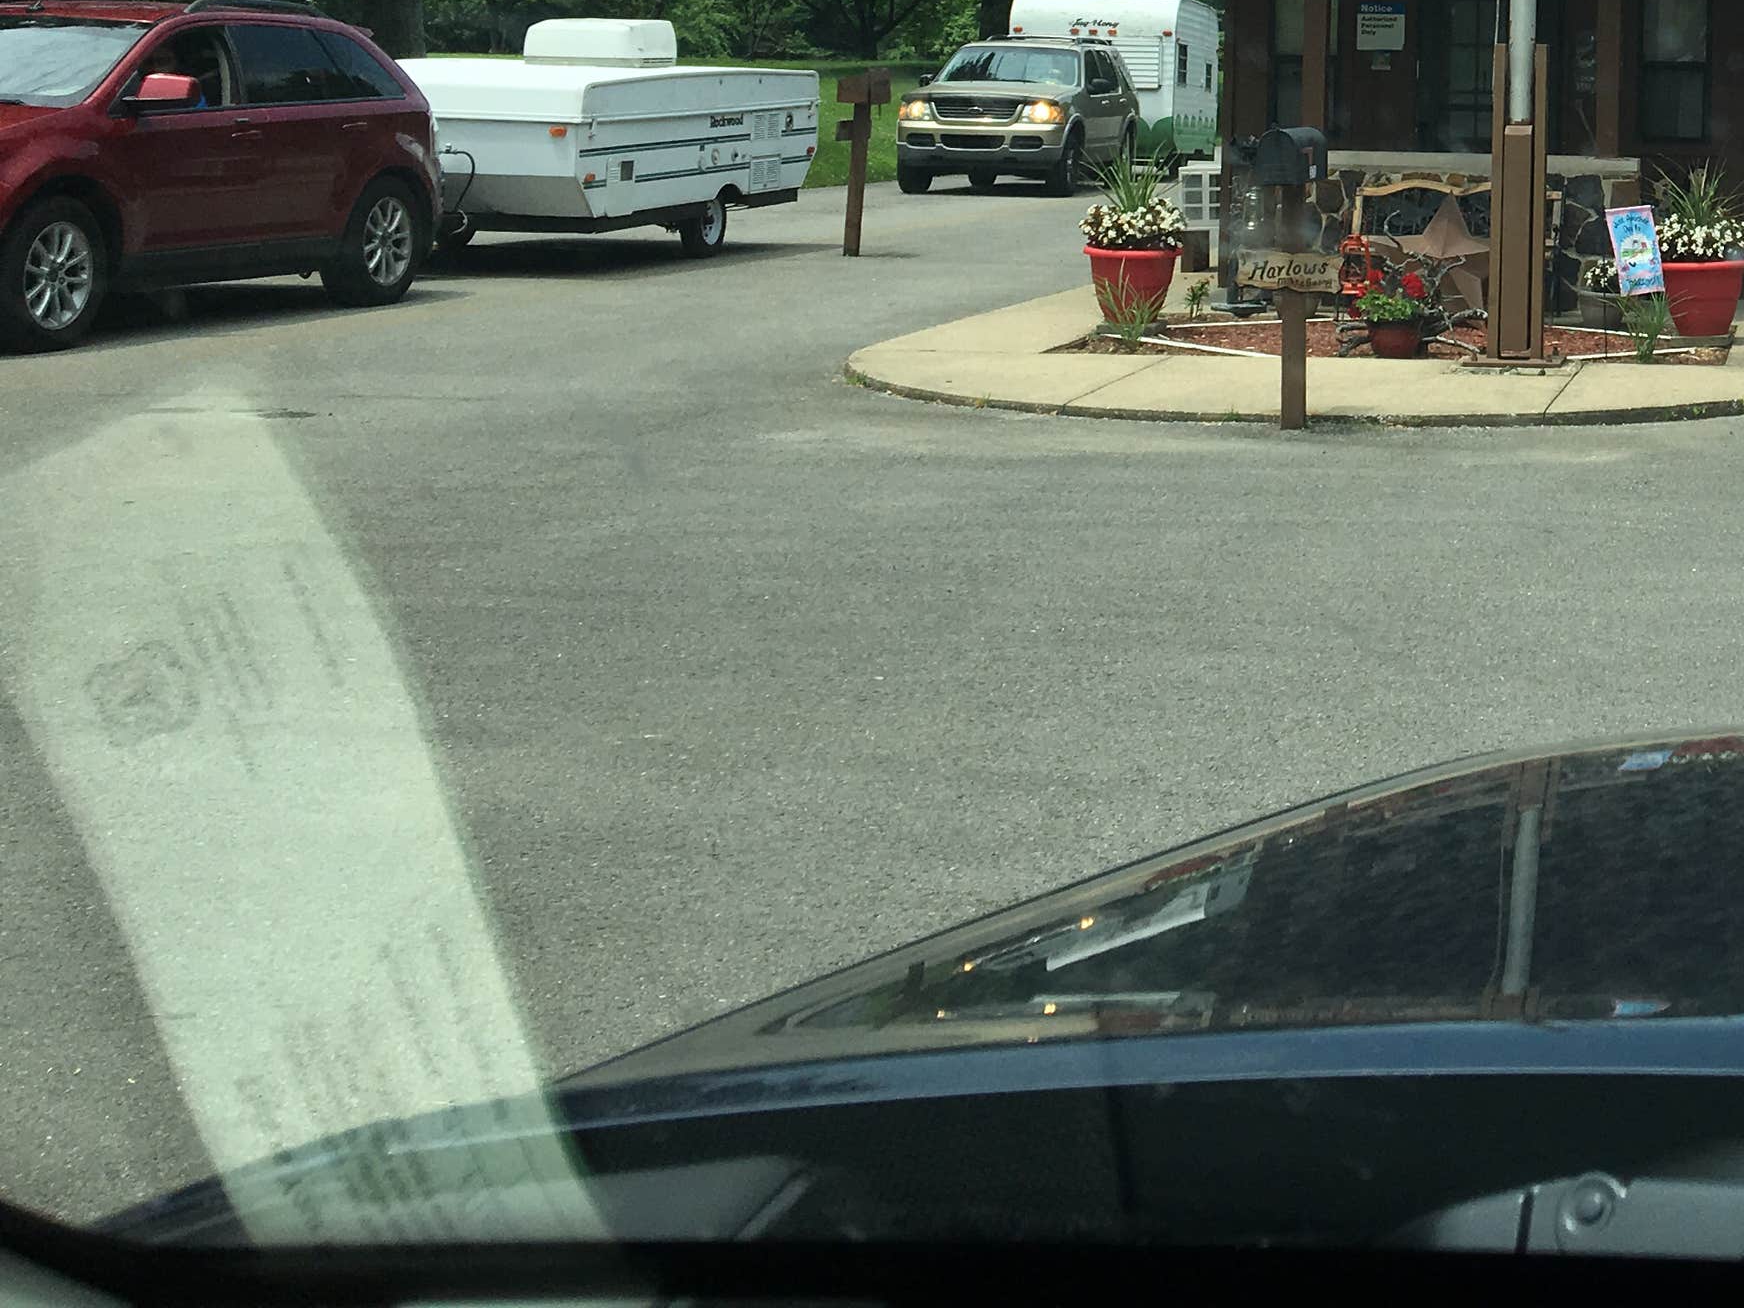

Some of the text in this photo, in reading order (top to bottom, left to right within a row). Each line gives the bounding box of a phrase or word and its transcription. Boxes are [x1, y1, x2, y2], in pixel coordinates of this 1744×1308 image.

[1360, 4, 1393, 12] Notice
[710, 113, 744, 128] Rockwood
[1248, 259, 1329, 280] Harlows
